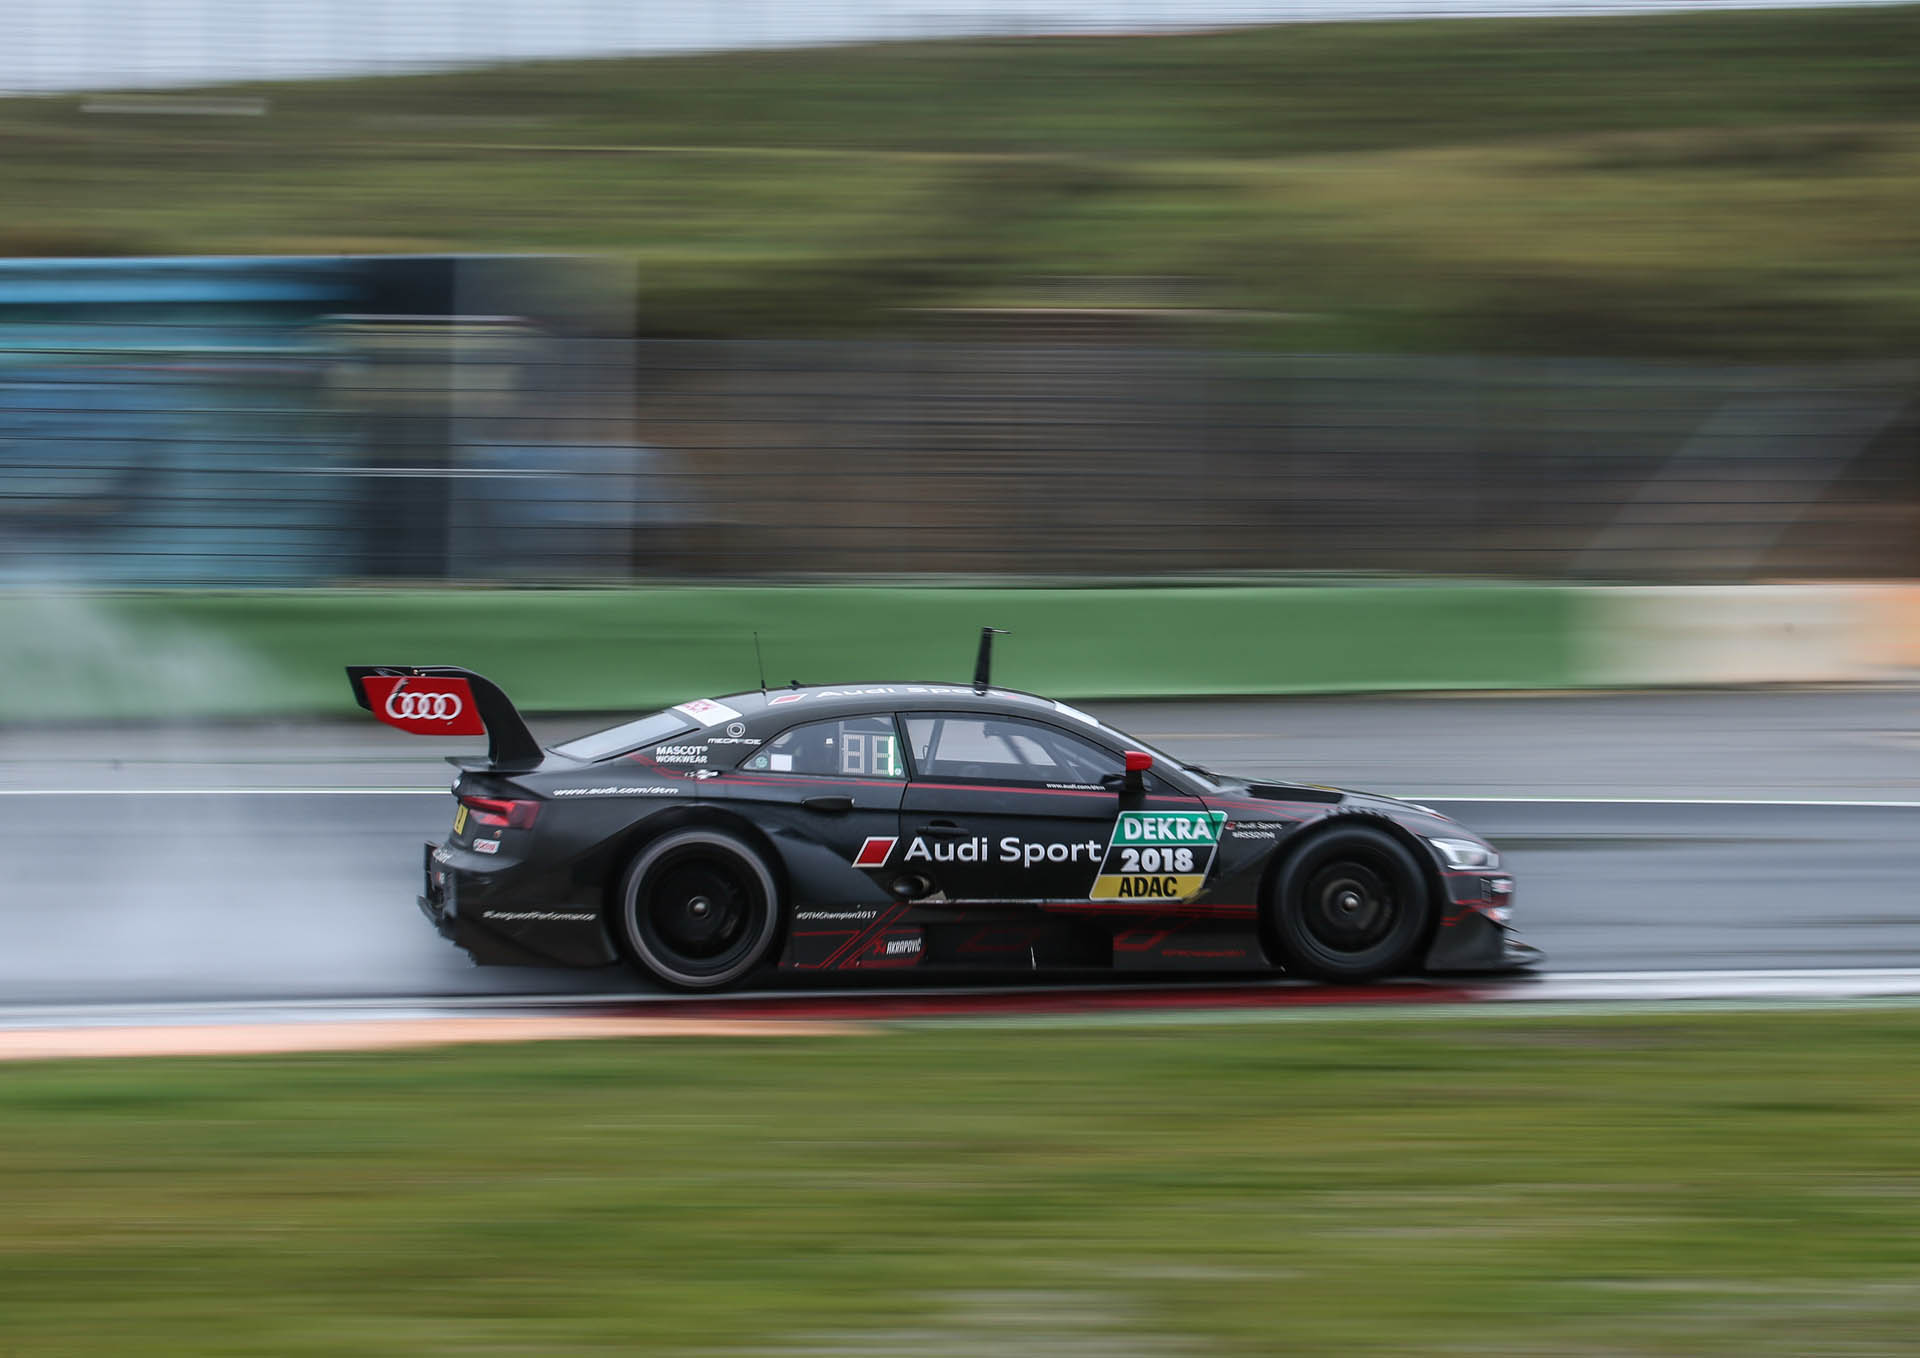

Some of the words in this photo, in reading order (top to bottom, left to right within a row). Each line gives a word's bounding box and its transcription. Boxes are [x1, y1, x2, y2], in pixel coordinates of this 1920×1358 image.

[815, 687, 894, 698] Audi
[656, 755, 708, 764] WORKWEAR
[553, 786, 679, 796] www.audi.com/dtm
[1124, 817, 1214, 840] DEKRA
[904, 836, 988, 862] Audi
[999, 836, 1102, 868] Sport
[1120, 848, 1194, 872] 2018
[1118, 876, 1178, 898] ADAC
